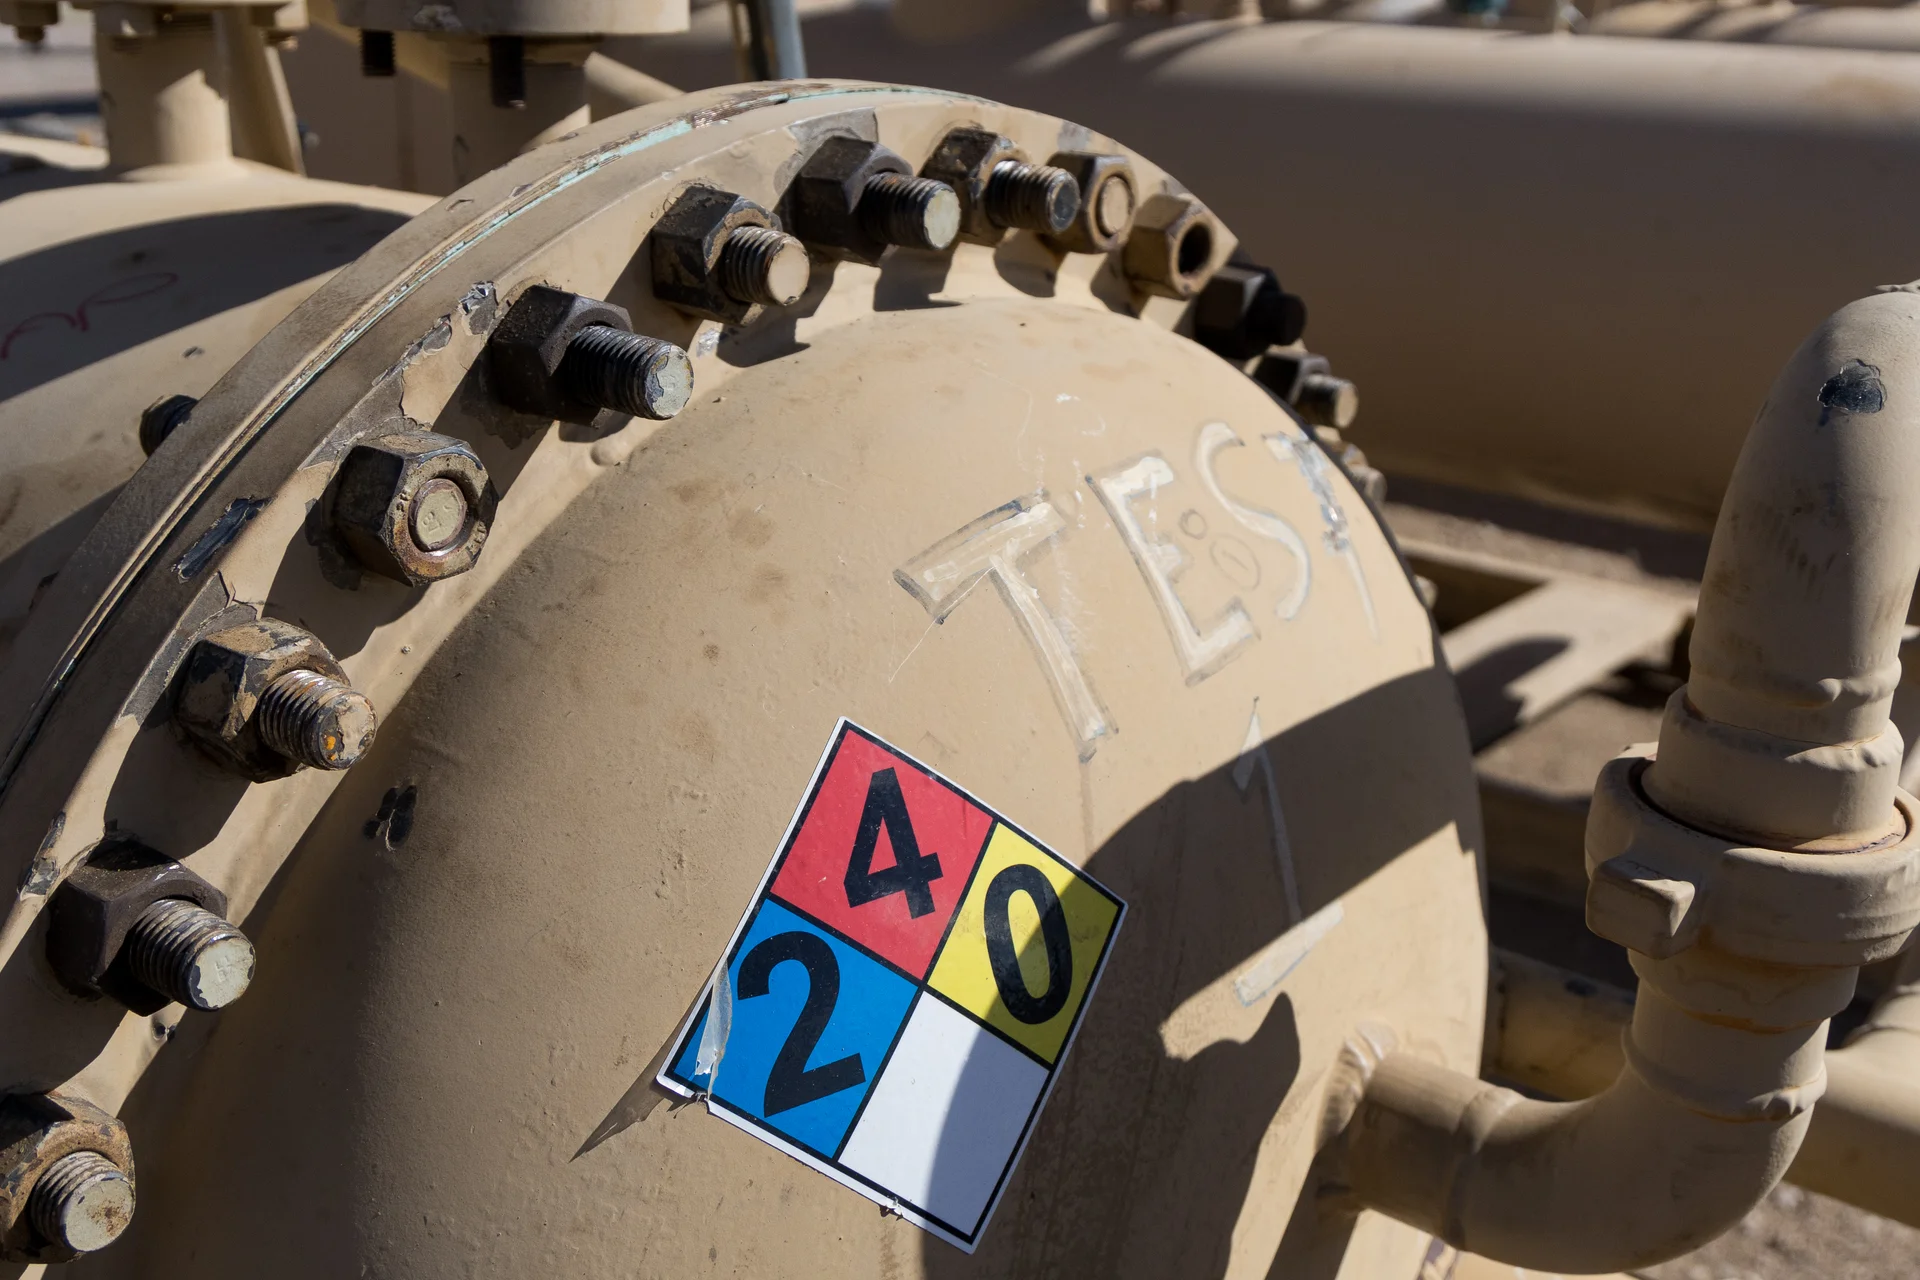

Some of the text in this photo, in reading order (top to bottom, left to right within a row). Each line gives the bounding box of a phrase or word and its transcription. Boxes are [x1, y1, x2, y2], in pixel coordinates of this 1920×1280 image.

[893, 420, 1379, 763] TEST
[843, 766, 944, 920] 4
[736, 930, 867, 1119] 2
[983, 862, 1073, 1025] 0
